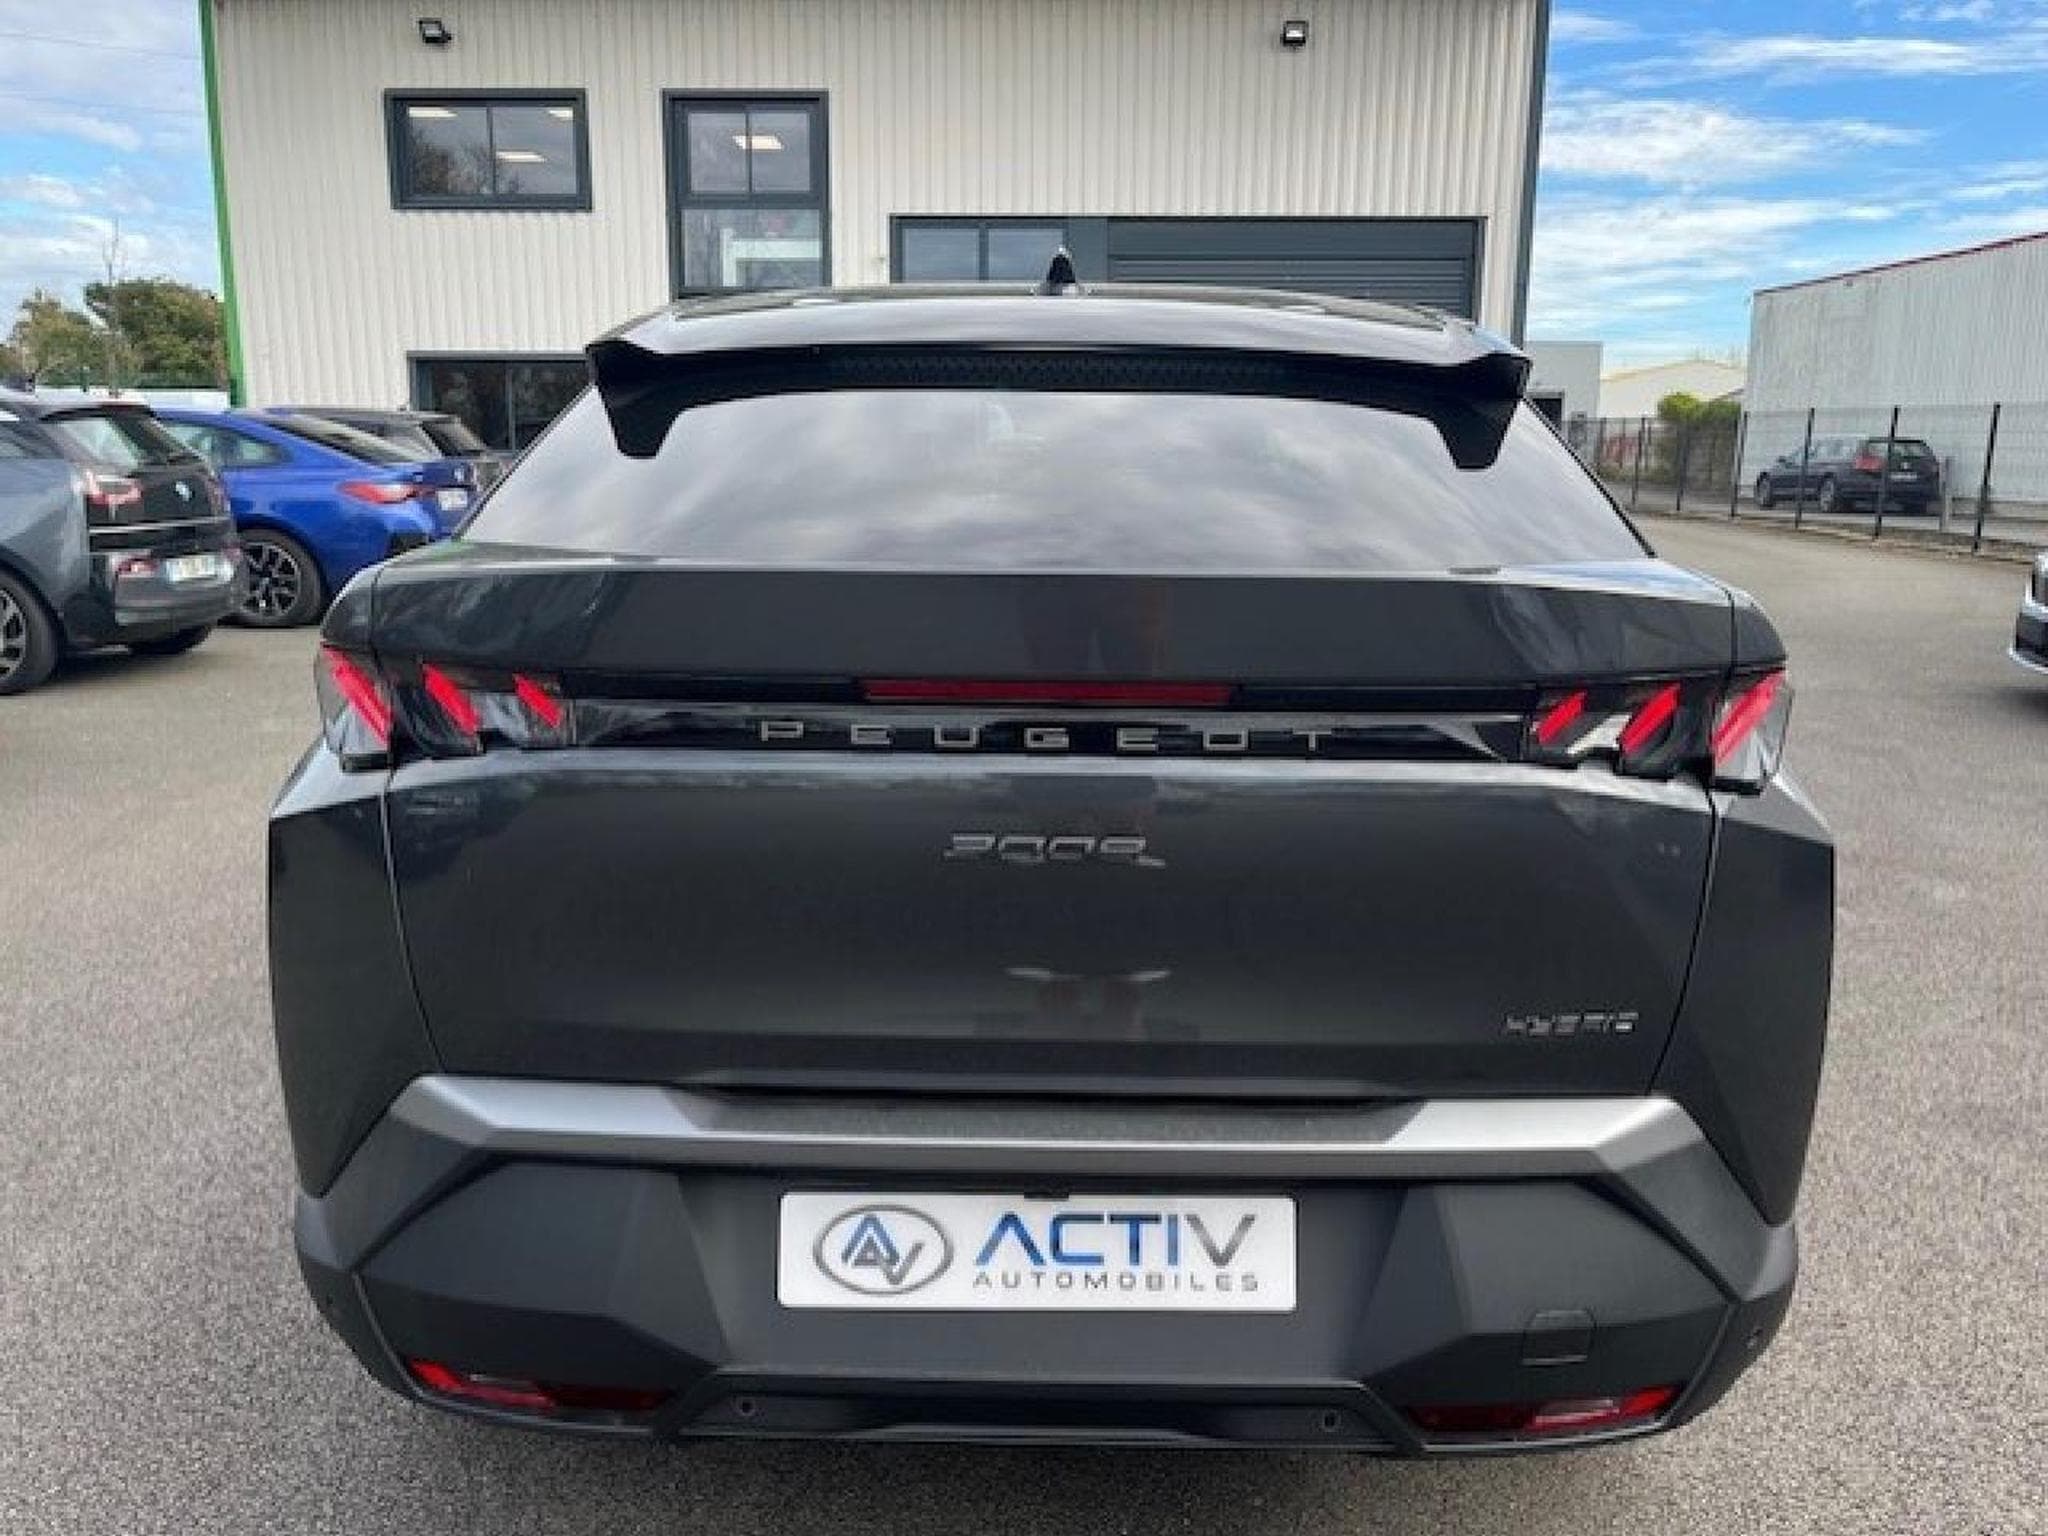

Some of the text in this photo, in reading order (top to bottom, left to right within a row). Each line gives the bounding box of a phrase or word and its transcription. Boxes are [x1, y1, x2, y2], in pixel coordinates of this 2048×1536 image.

[761, 720, 1332, 752] PEUGEOT
[976, 1211, 1256, 1268] ACTIV
[973, 1271, 1259, 1293] AUTOMOBILES
